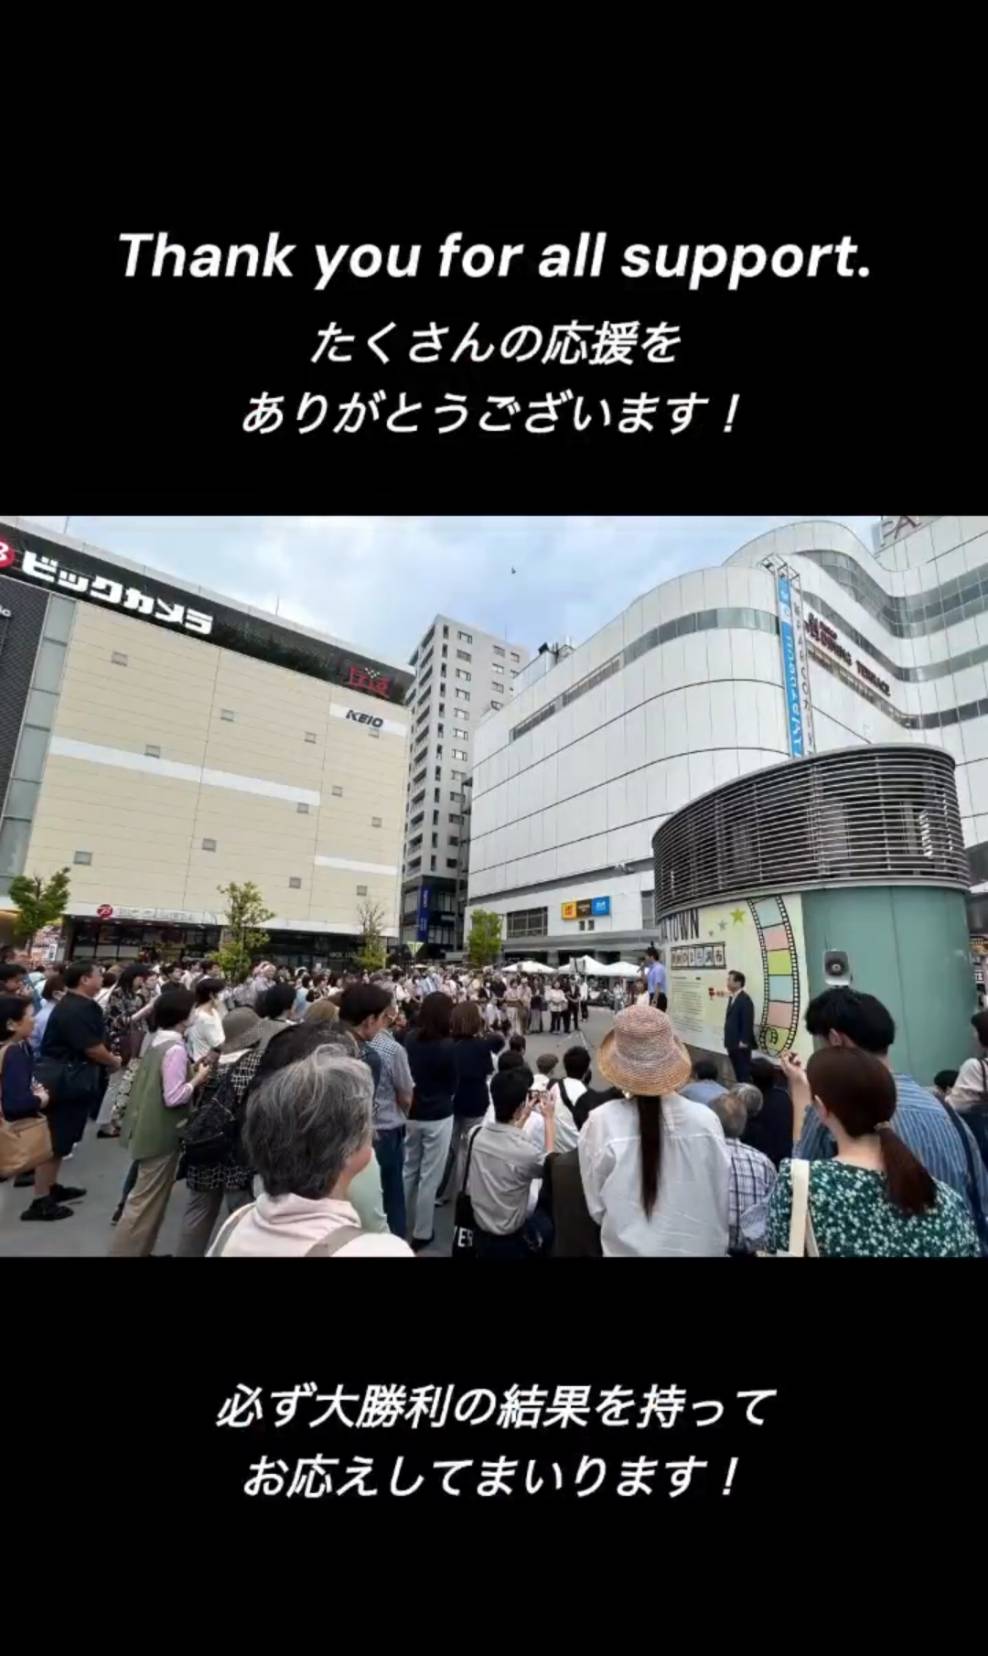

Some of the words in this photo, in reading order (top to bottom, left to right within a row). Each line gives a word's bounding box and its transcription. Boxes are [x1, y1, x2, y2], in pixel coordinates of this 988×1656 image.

[21, 549, 214, 635] ビックカメラ
[345, 709, 384, 728] KEIO
